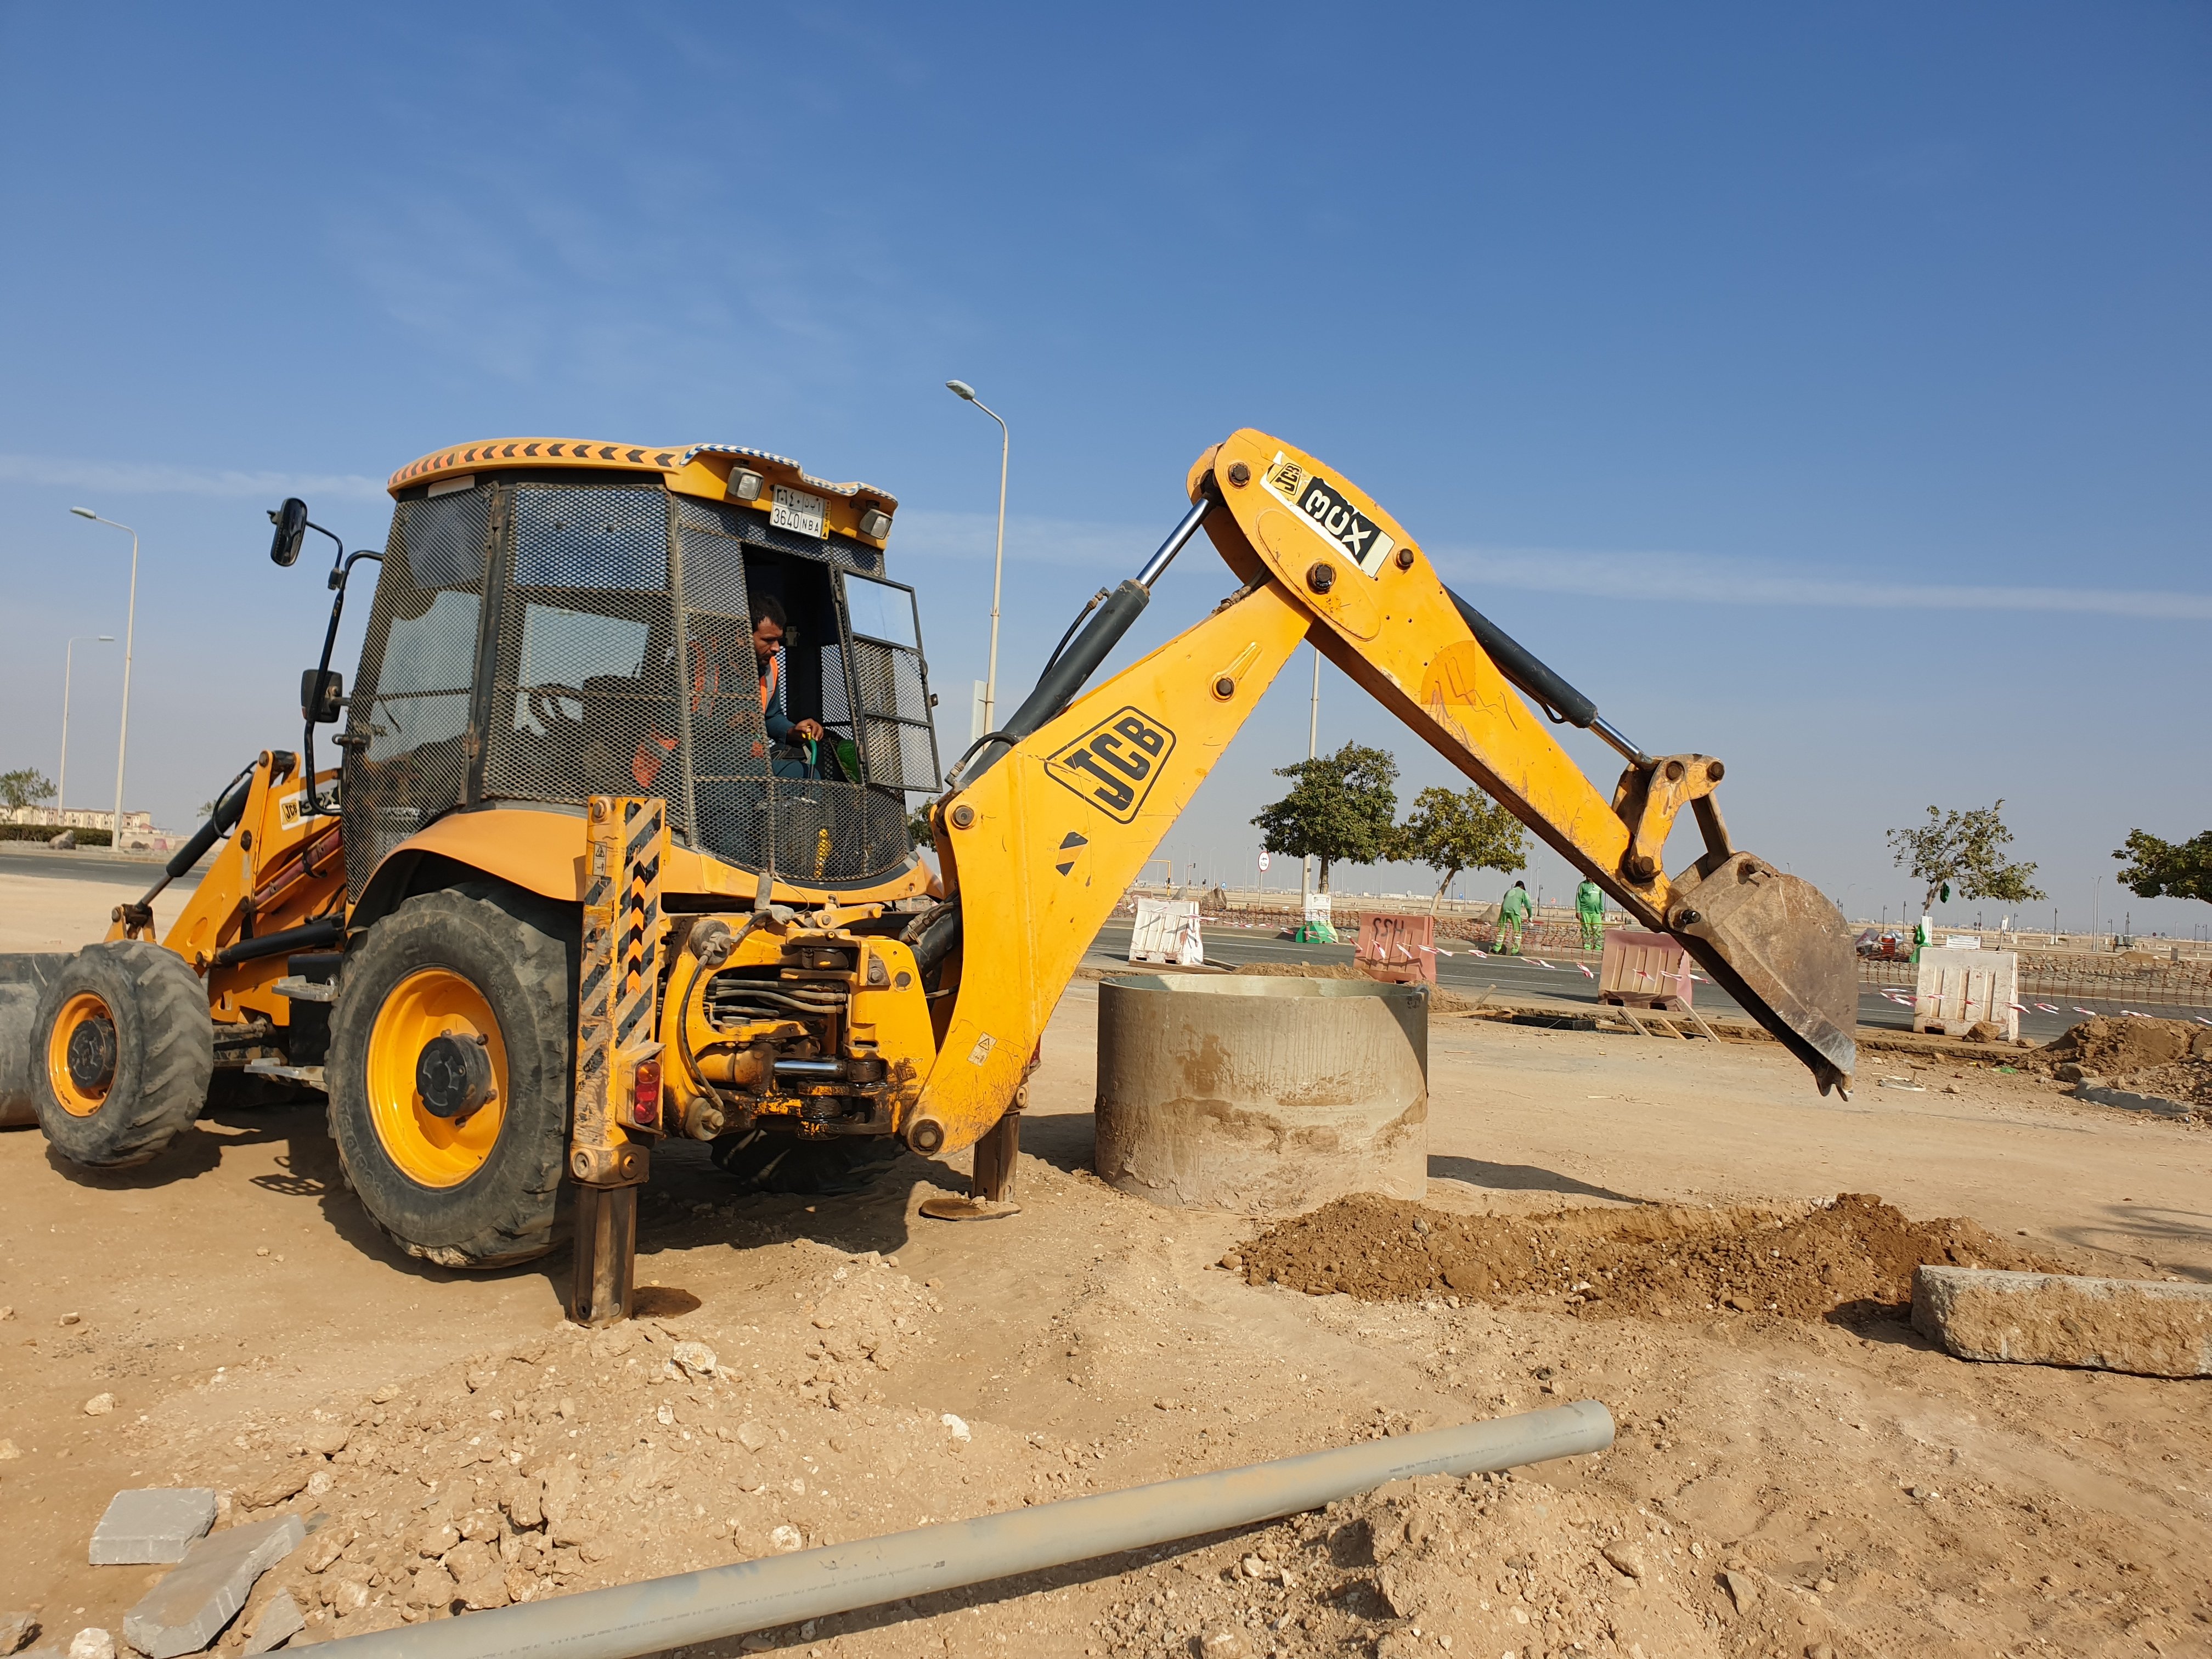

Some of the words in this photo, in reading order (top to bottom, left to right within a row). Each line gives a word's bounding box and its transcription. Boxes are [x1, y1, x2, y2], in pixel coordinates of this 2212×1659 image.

[1274, 465, 1300, 492] JCB
[774, 508, 799, 529] 3640
[802, 518, 819, 533] NBA
[1305, 489, 1372, 556] 3CX
[1063, 716, 1165, 811] JCB
[285, 804, 298, 820] JCB
